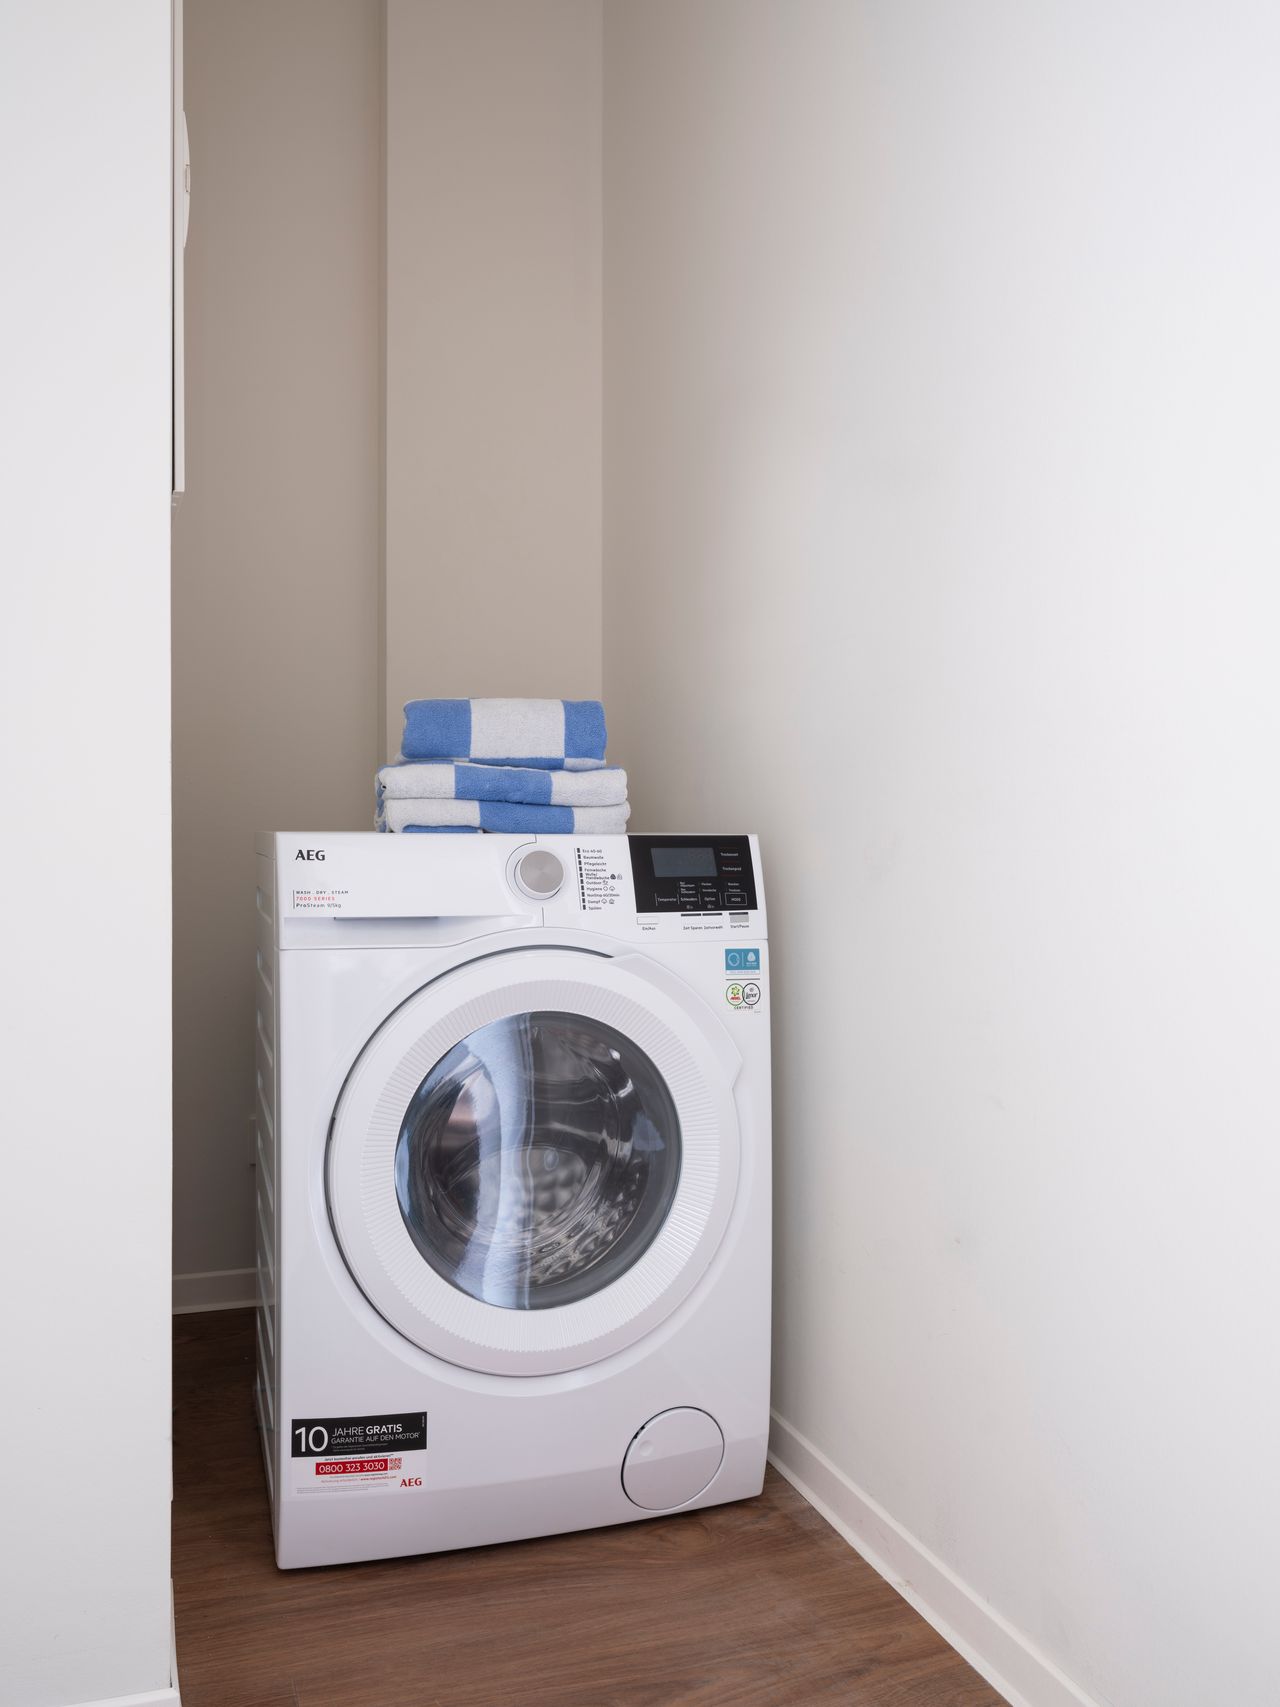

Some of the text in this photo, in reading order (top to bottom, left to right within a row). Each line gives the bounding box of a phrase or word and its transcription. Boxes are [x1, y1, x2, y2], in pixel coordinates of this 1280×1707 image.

[295, 849, 325, 861] AEG
[332, 1424, 402, 1437] JAHRE GRATIS
[295, 1426, 329, 1452] 10
[319, 1462, 385, 1473] 0800 323 3030
[400, 1477, 422, 1487] AEG
